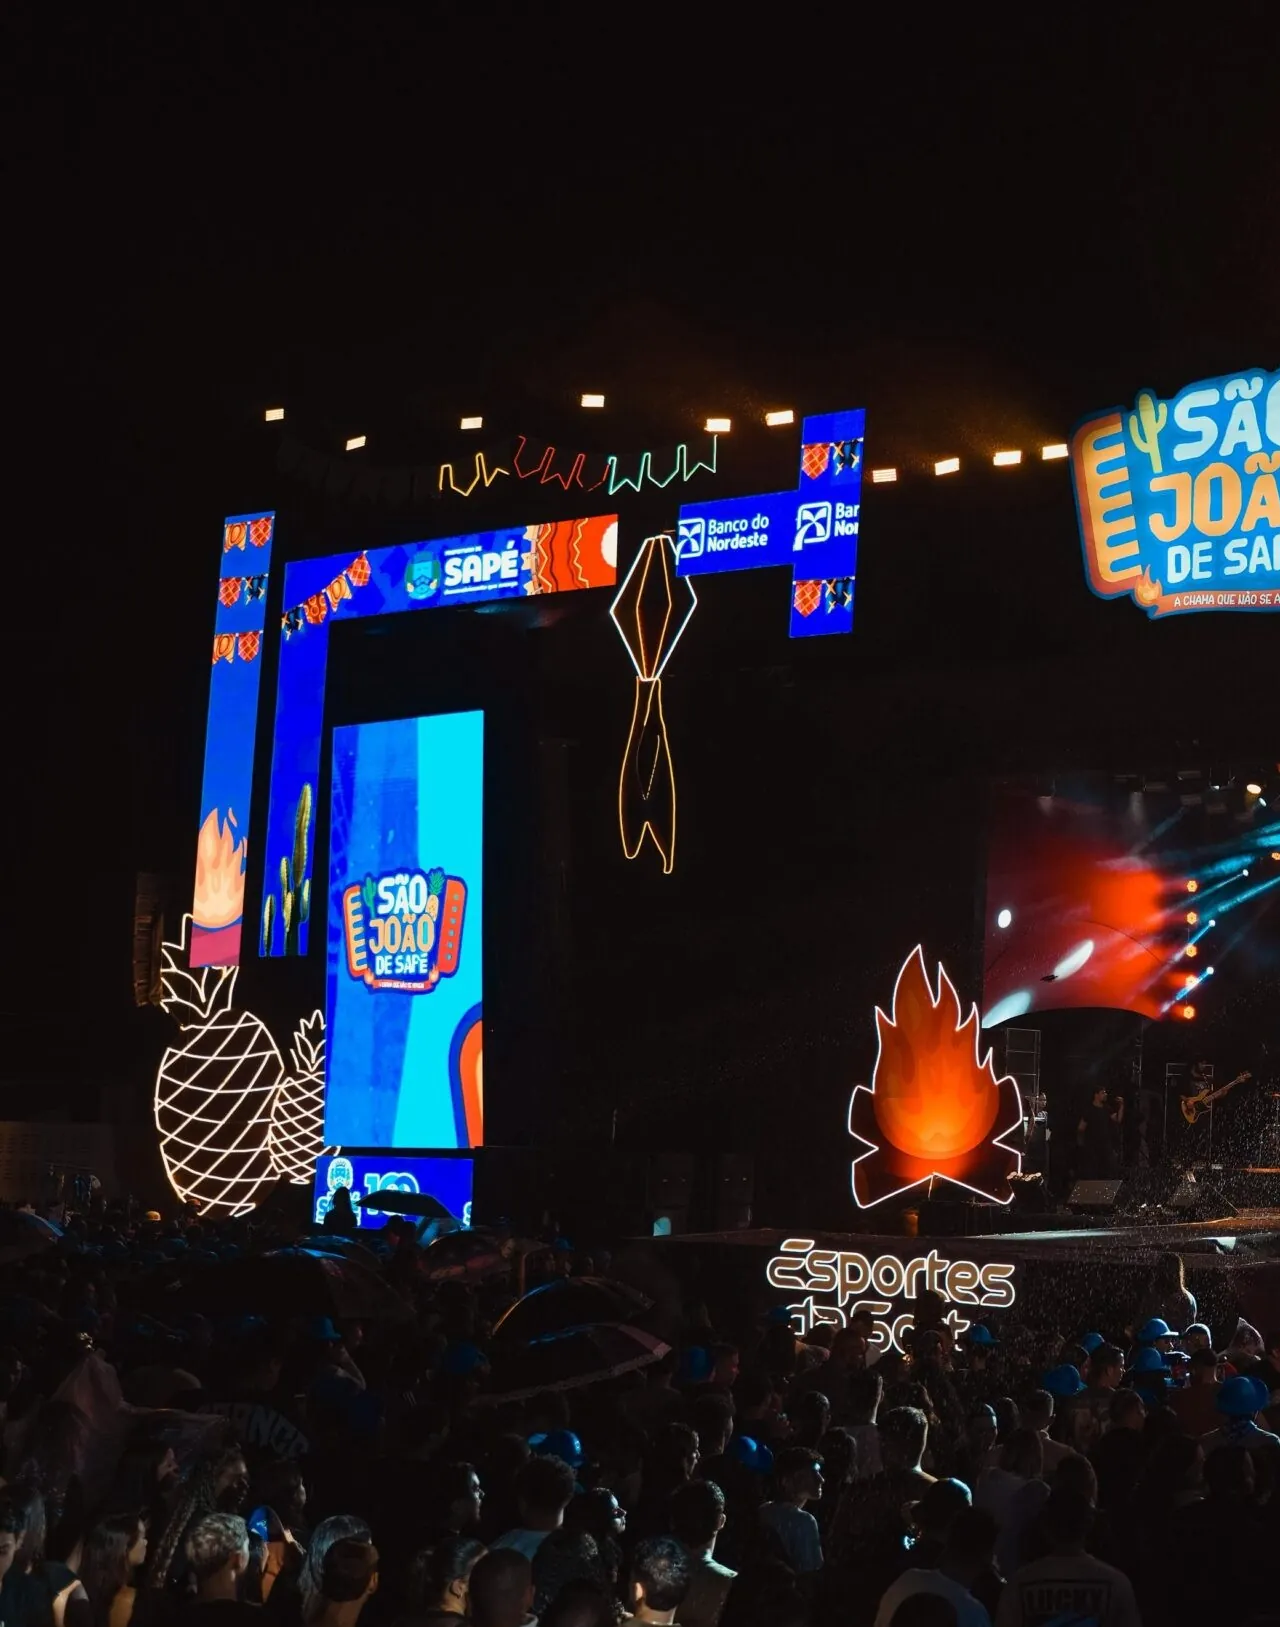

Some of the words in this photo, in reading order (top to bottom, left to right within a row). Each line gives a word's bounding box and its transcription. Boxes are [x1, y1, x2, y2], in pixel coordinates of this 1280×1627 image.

[708, 518, 748, 536] Banco
[751, 513, 770, 530] do
[707, 532, 769, 552] Nordeste
[444, 540, 519, 587] SAPÉ
[1167, 541, 1213, 584] DE
[1173, 596, 1181, 607] A
[1217, 594, 1237, 605] QUE
[1259, 593, 1273, 605] SE
[377, 873, 428, 915] SÃO
[369, 912, 435, 954] JOÃO
[375, 955, 393, 976] DE
[394, 952, 428, 975] SAPÉ
